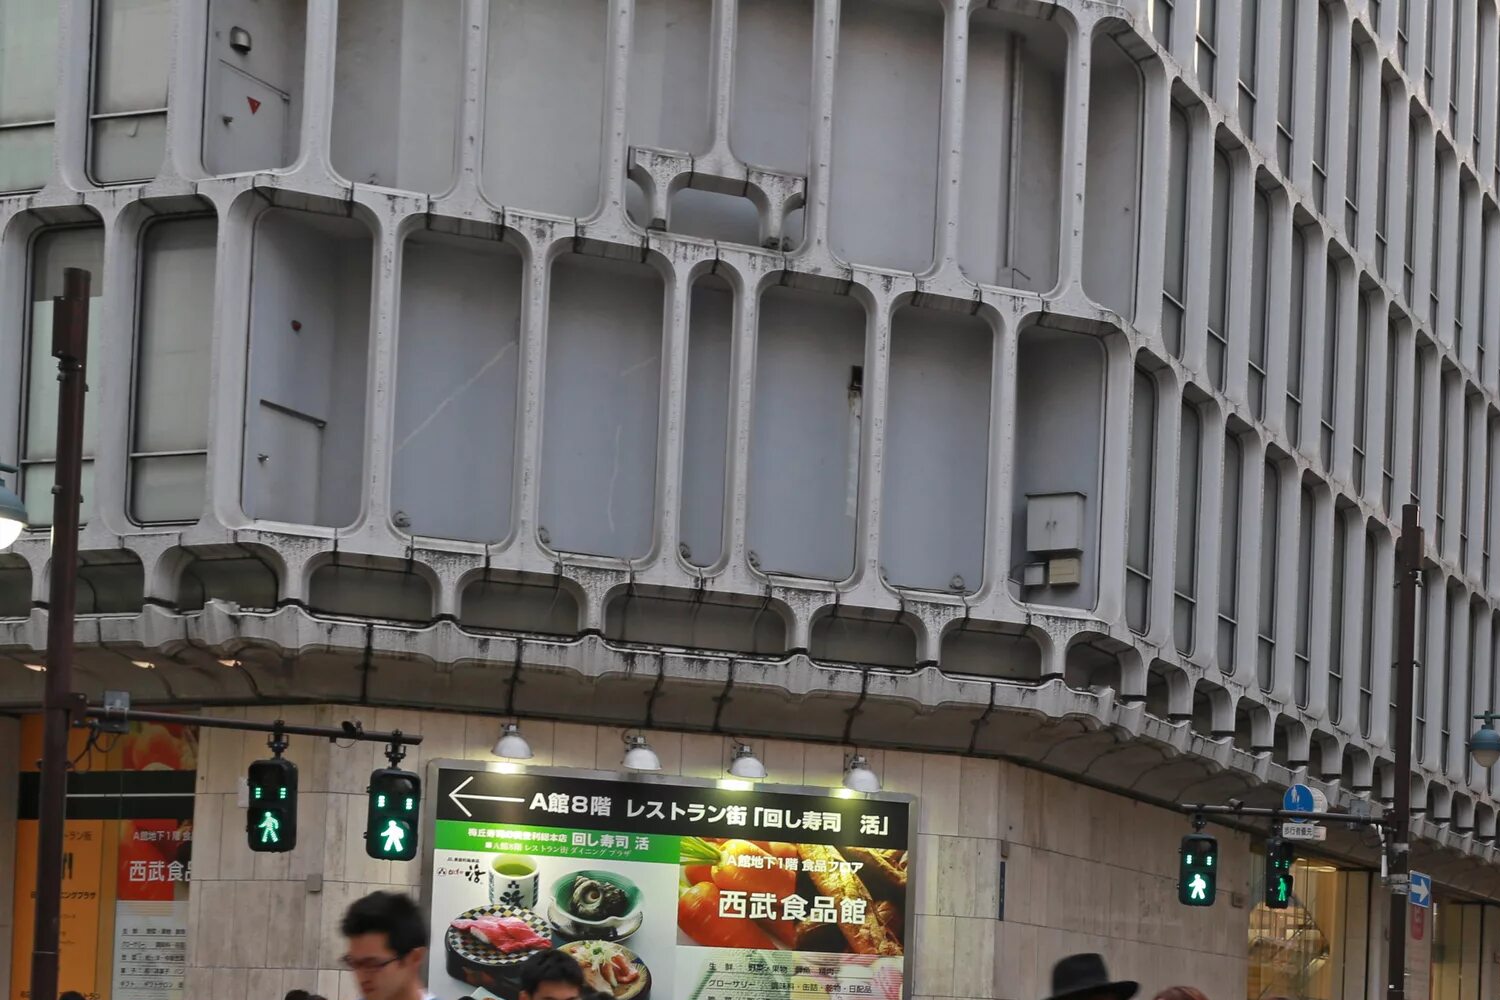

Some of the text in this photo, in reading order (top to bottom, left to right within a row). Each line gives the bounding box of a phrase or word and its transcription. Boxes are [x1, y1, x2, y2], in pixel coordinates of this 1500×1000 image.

[529, 792, 612, 818] A館8階
[571, 832, 629, 849] 回し寿司
[634, 836, 650, 851] 活
[727, 853, 864, 875] A館地下1階 食品フロア
[718, 889, 868, 926] 西武食品館
[708, 980, 756, 988] グローサリー
